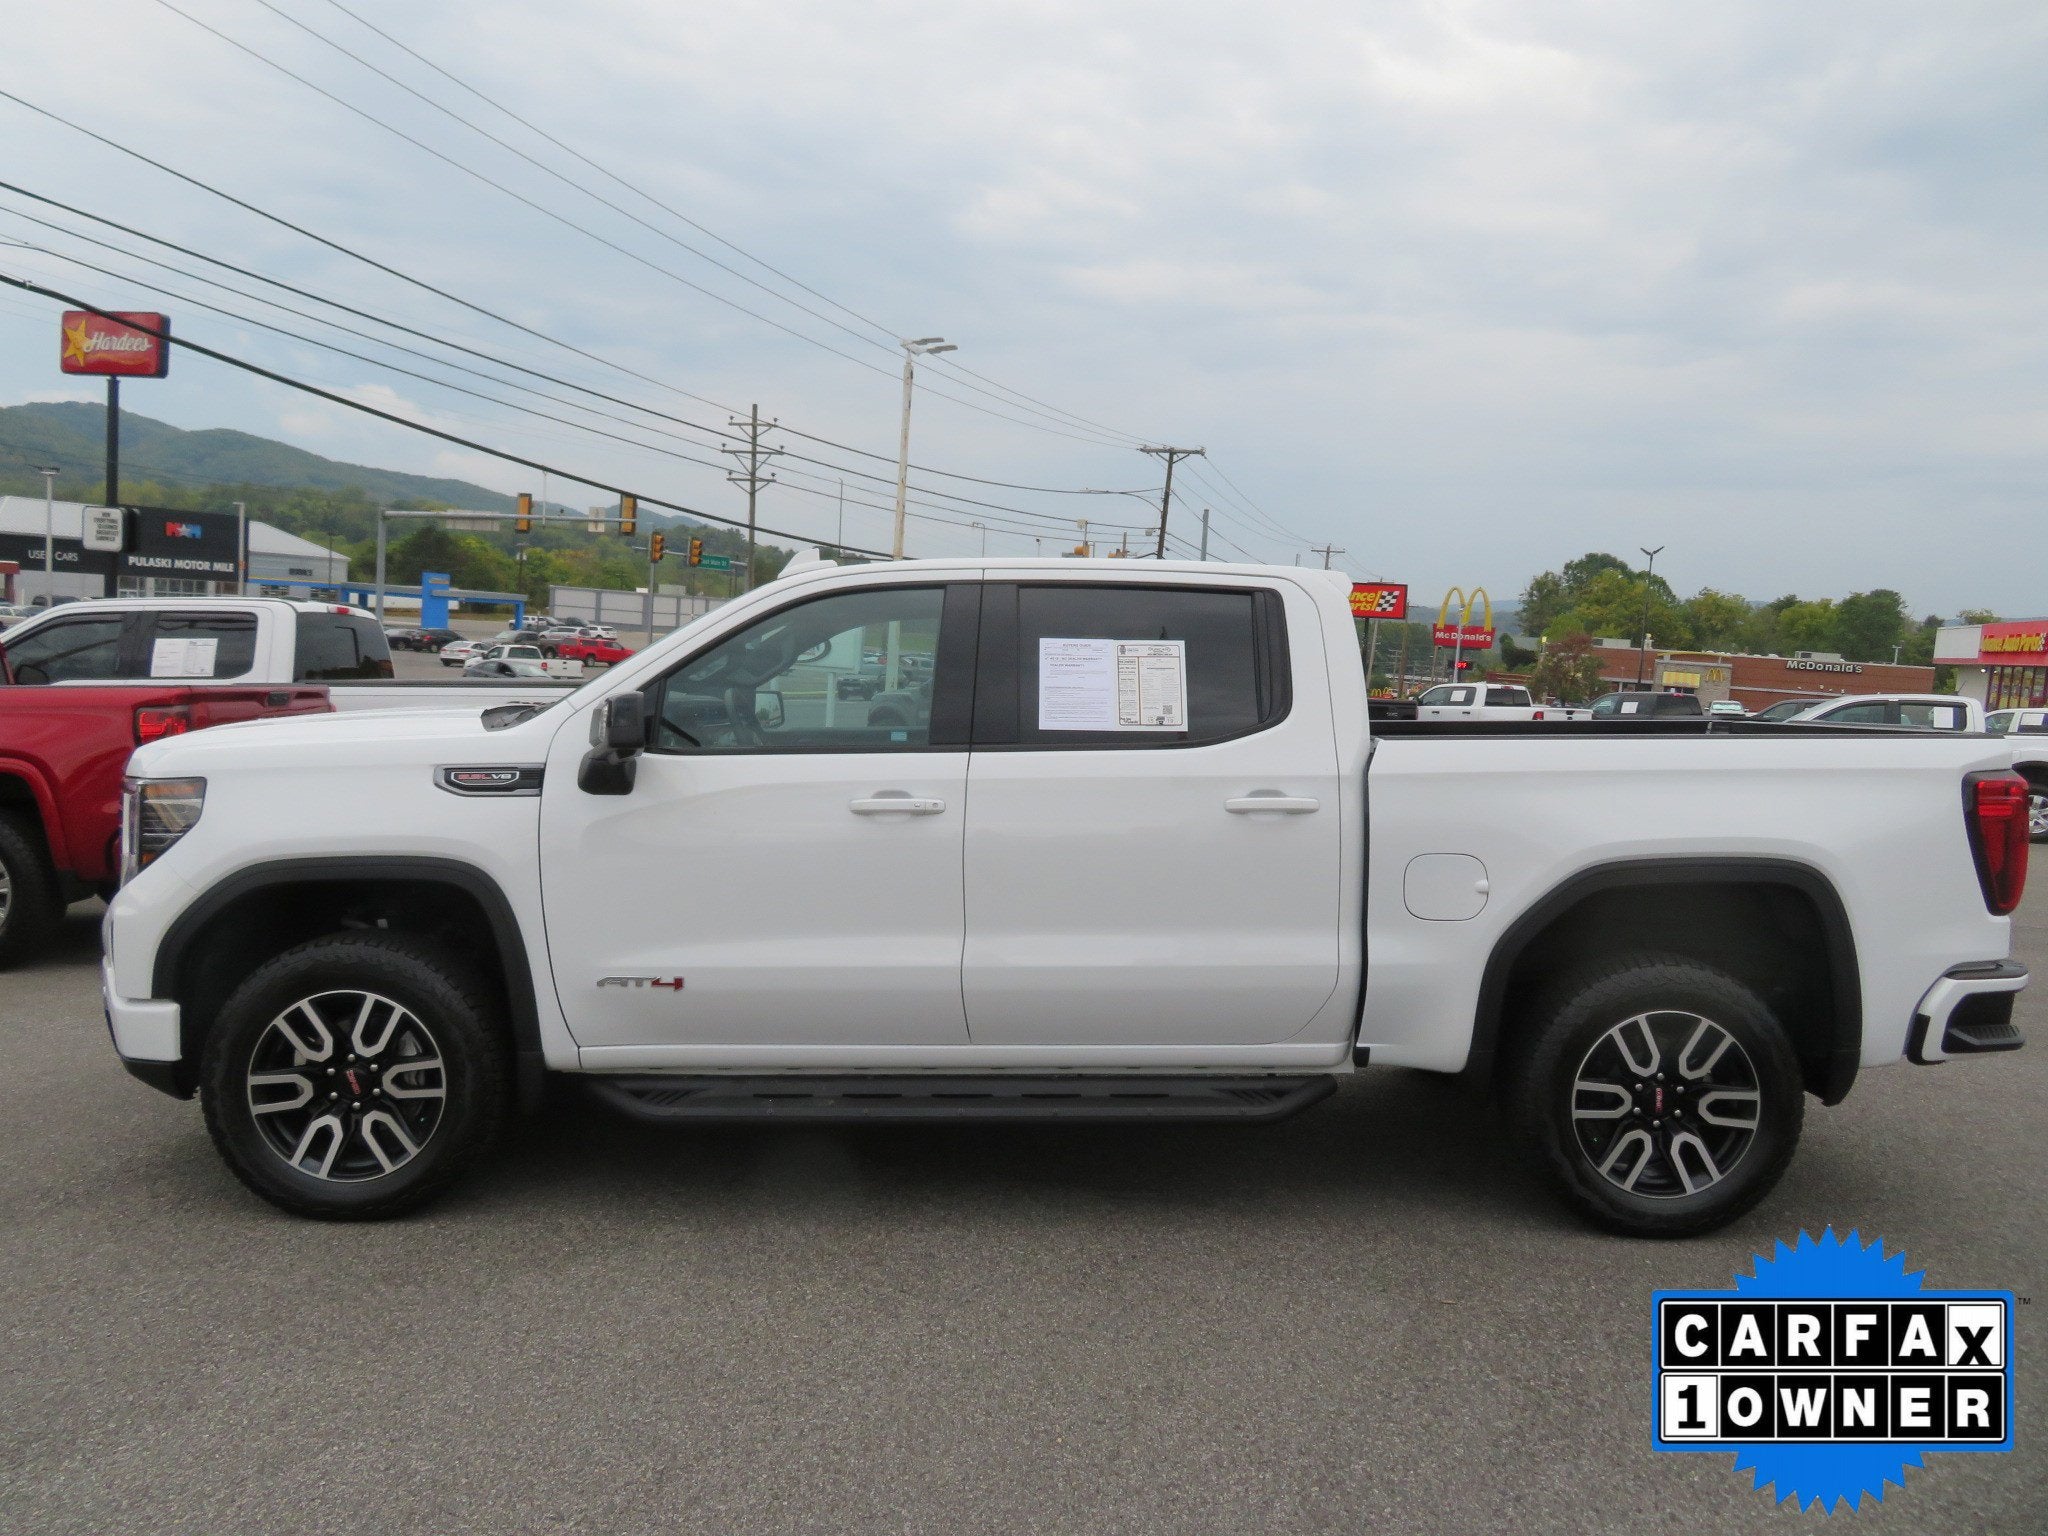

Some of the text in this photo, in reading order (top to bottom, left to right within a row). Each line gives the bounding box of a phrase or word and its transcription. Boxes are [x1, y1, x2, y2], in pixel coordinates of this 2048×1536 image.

[28, 550, 78, 562] USE CARS
[128, 556, 234, 573] PULASKI MOTOR MILE
[1786, 660, 1863, 674] McDonald's
[597, 976, 684, 992] AT4
